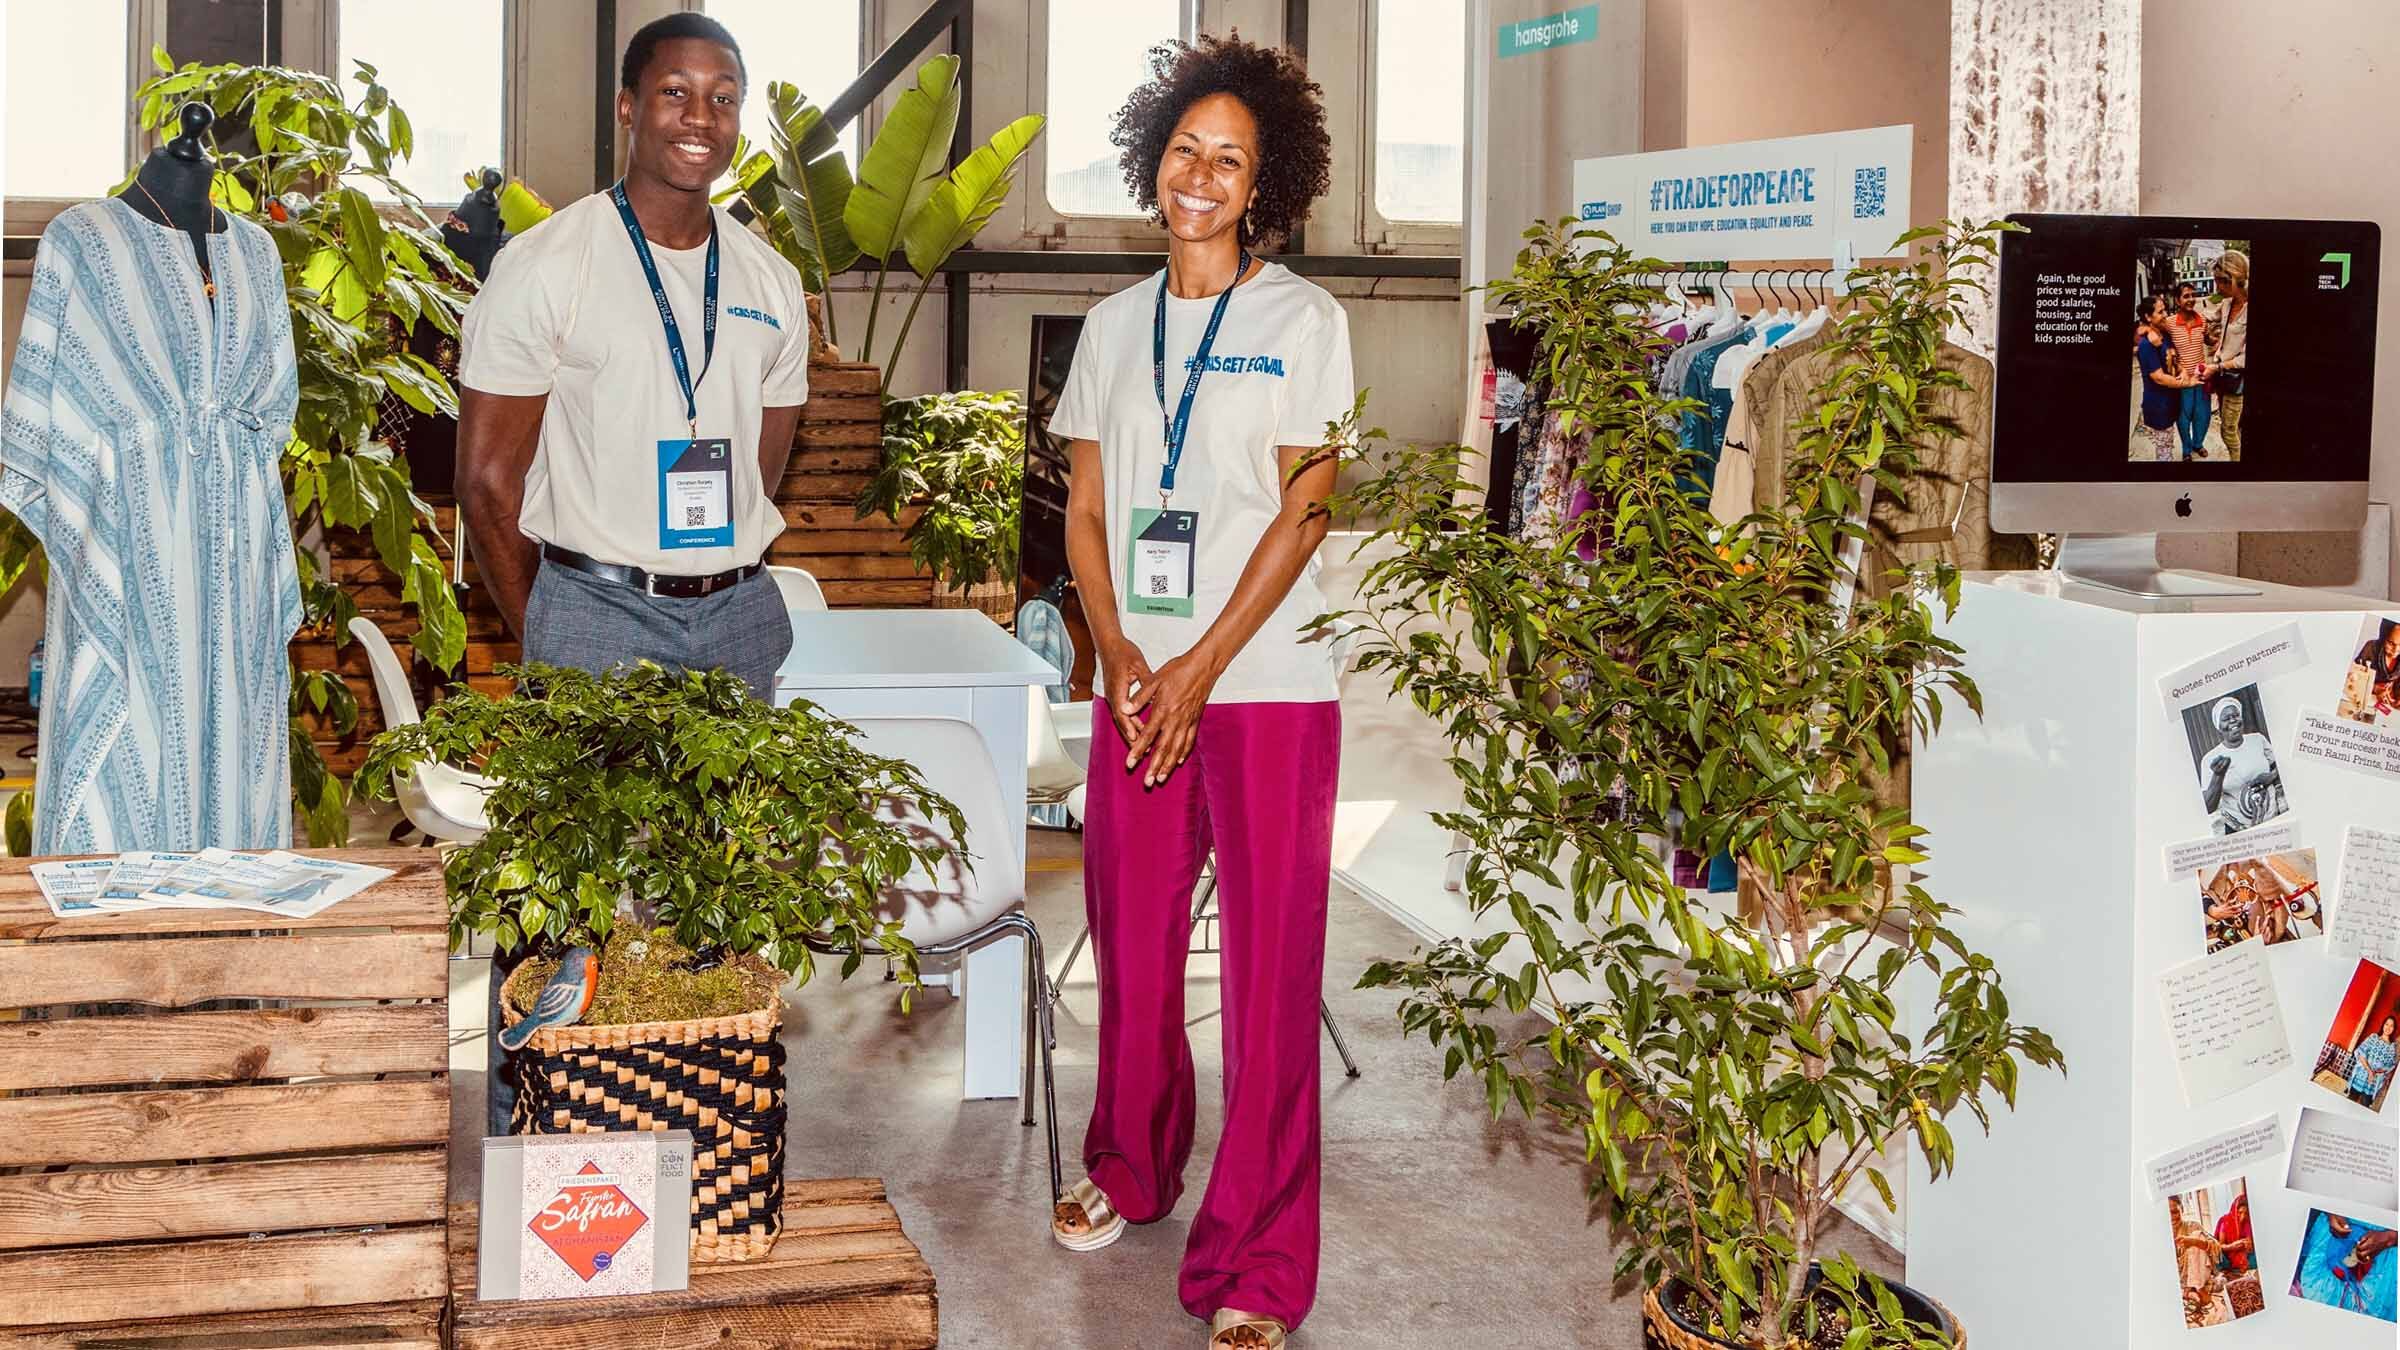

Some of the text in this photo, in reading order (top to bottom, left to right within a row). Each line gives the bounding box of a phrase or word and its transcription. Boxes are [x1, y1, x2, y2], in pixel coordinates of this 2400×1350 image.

[1515, 11, 1578, 48] hansgrohe
[1650, 168, 1816, 211] #TRADEFORPEACE
[1651, 222, 1663, 233] HERE
[1665, 222, 1675, 233] YOU
[1676, 221, 1686, 232] CAN
[1688, 221, 1698, 232] BUY
[1700, 219, 1715, 232] HOPE,
[1750, 216, 1777, 231] EQUALITY
[1780, 216, 1791, 228] AND
[1793, 214, 1814, 228] PEACE.
[2037, 273, 2105, 285] Again, the good
[2037, 286, 2120, 297] prices we pay make
[2036, 297, 2096, 308] good salaries,
[2035, 309, 2092, 320] housing, and
[2035, 321, 2109, 332] education for the
[2034, 333, 2093, 344] kids possible.
[1222, 357, 1247, 374] GET
[1247, 355, 1284, 377] EQUAL
[2172, 641, 2291, 698] Quotes from our partners:
[2302, 730, 2313, 740] on
[2315, 734, 2340, 746] your
[2335, 725, 2351, 735] me
[2352, 729, 2378, 743] piggy
[2299, 743, 2322, 755] from
[2324, 748, 2350, 762] Rami
[2352, 755, 2382, 771] Prints,
[542, 1193, 634, 1232] Safran
